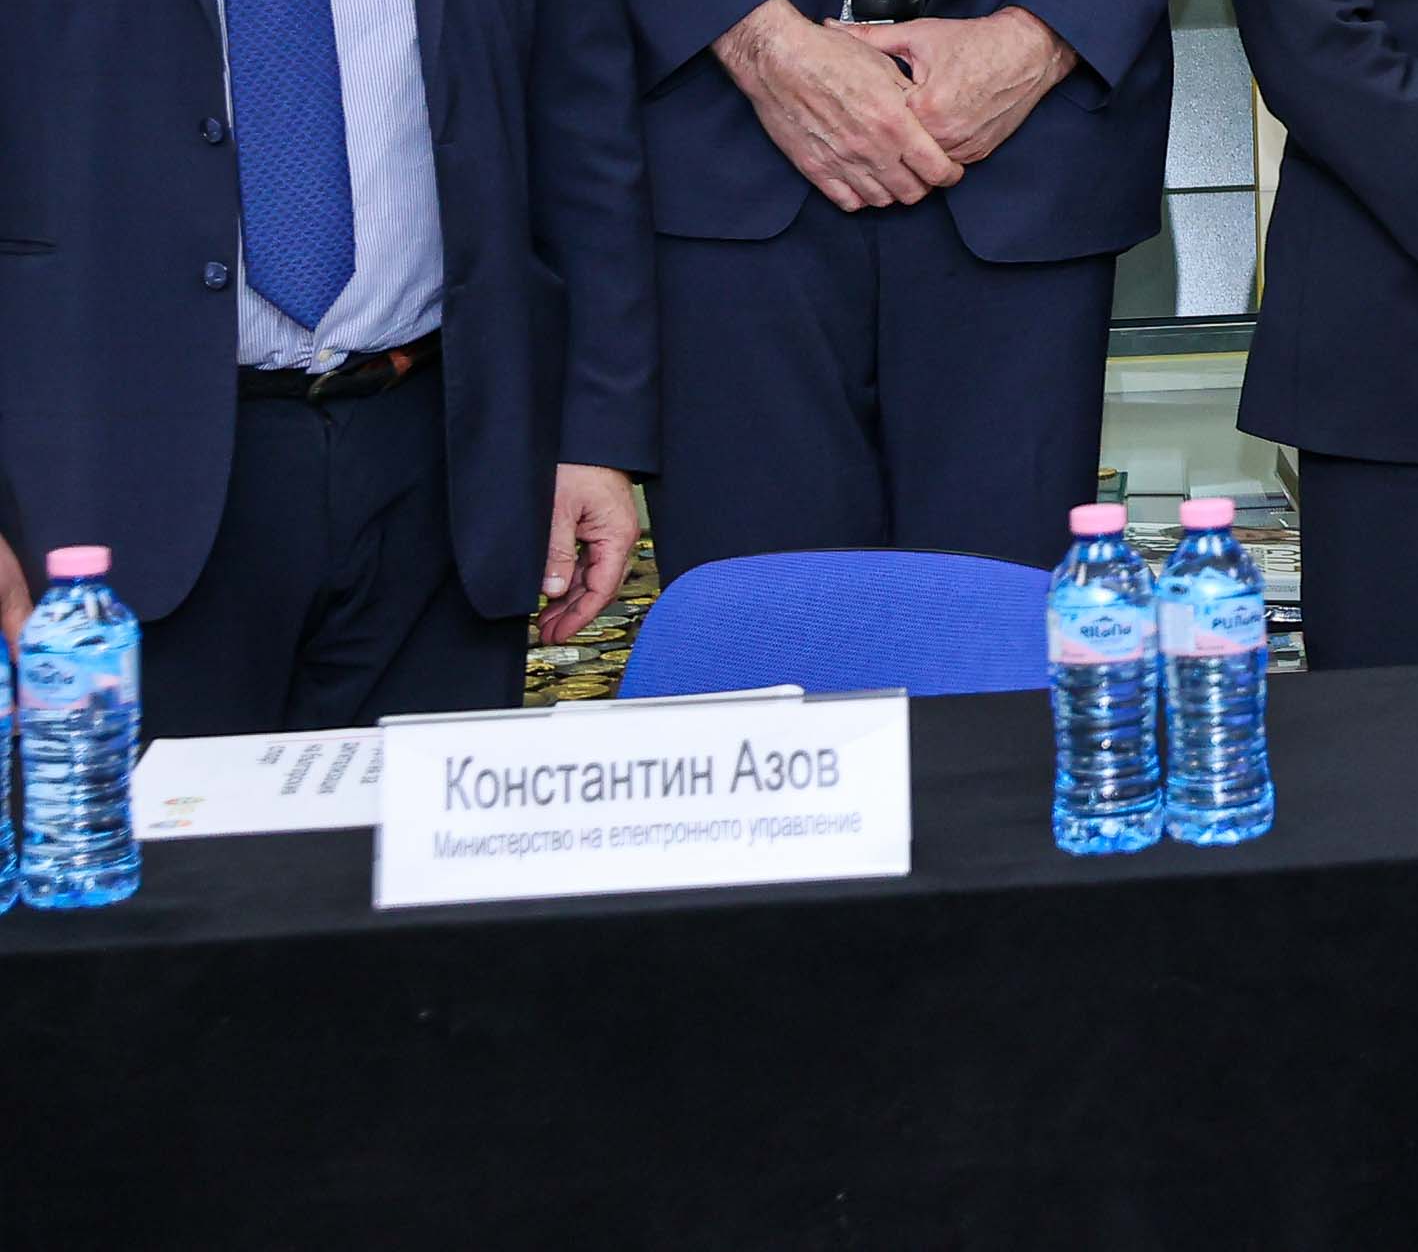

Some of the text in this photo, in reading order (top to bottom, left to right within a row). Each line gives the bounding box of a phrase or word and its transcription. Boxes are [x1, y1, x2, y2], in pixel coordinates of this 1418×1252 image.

[444, 754, 714, 810] Константин
[730, 739, 840, 792] Азов
[433, 810, 862, 860] Министерство на електронното управление
